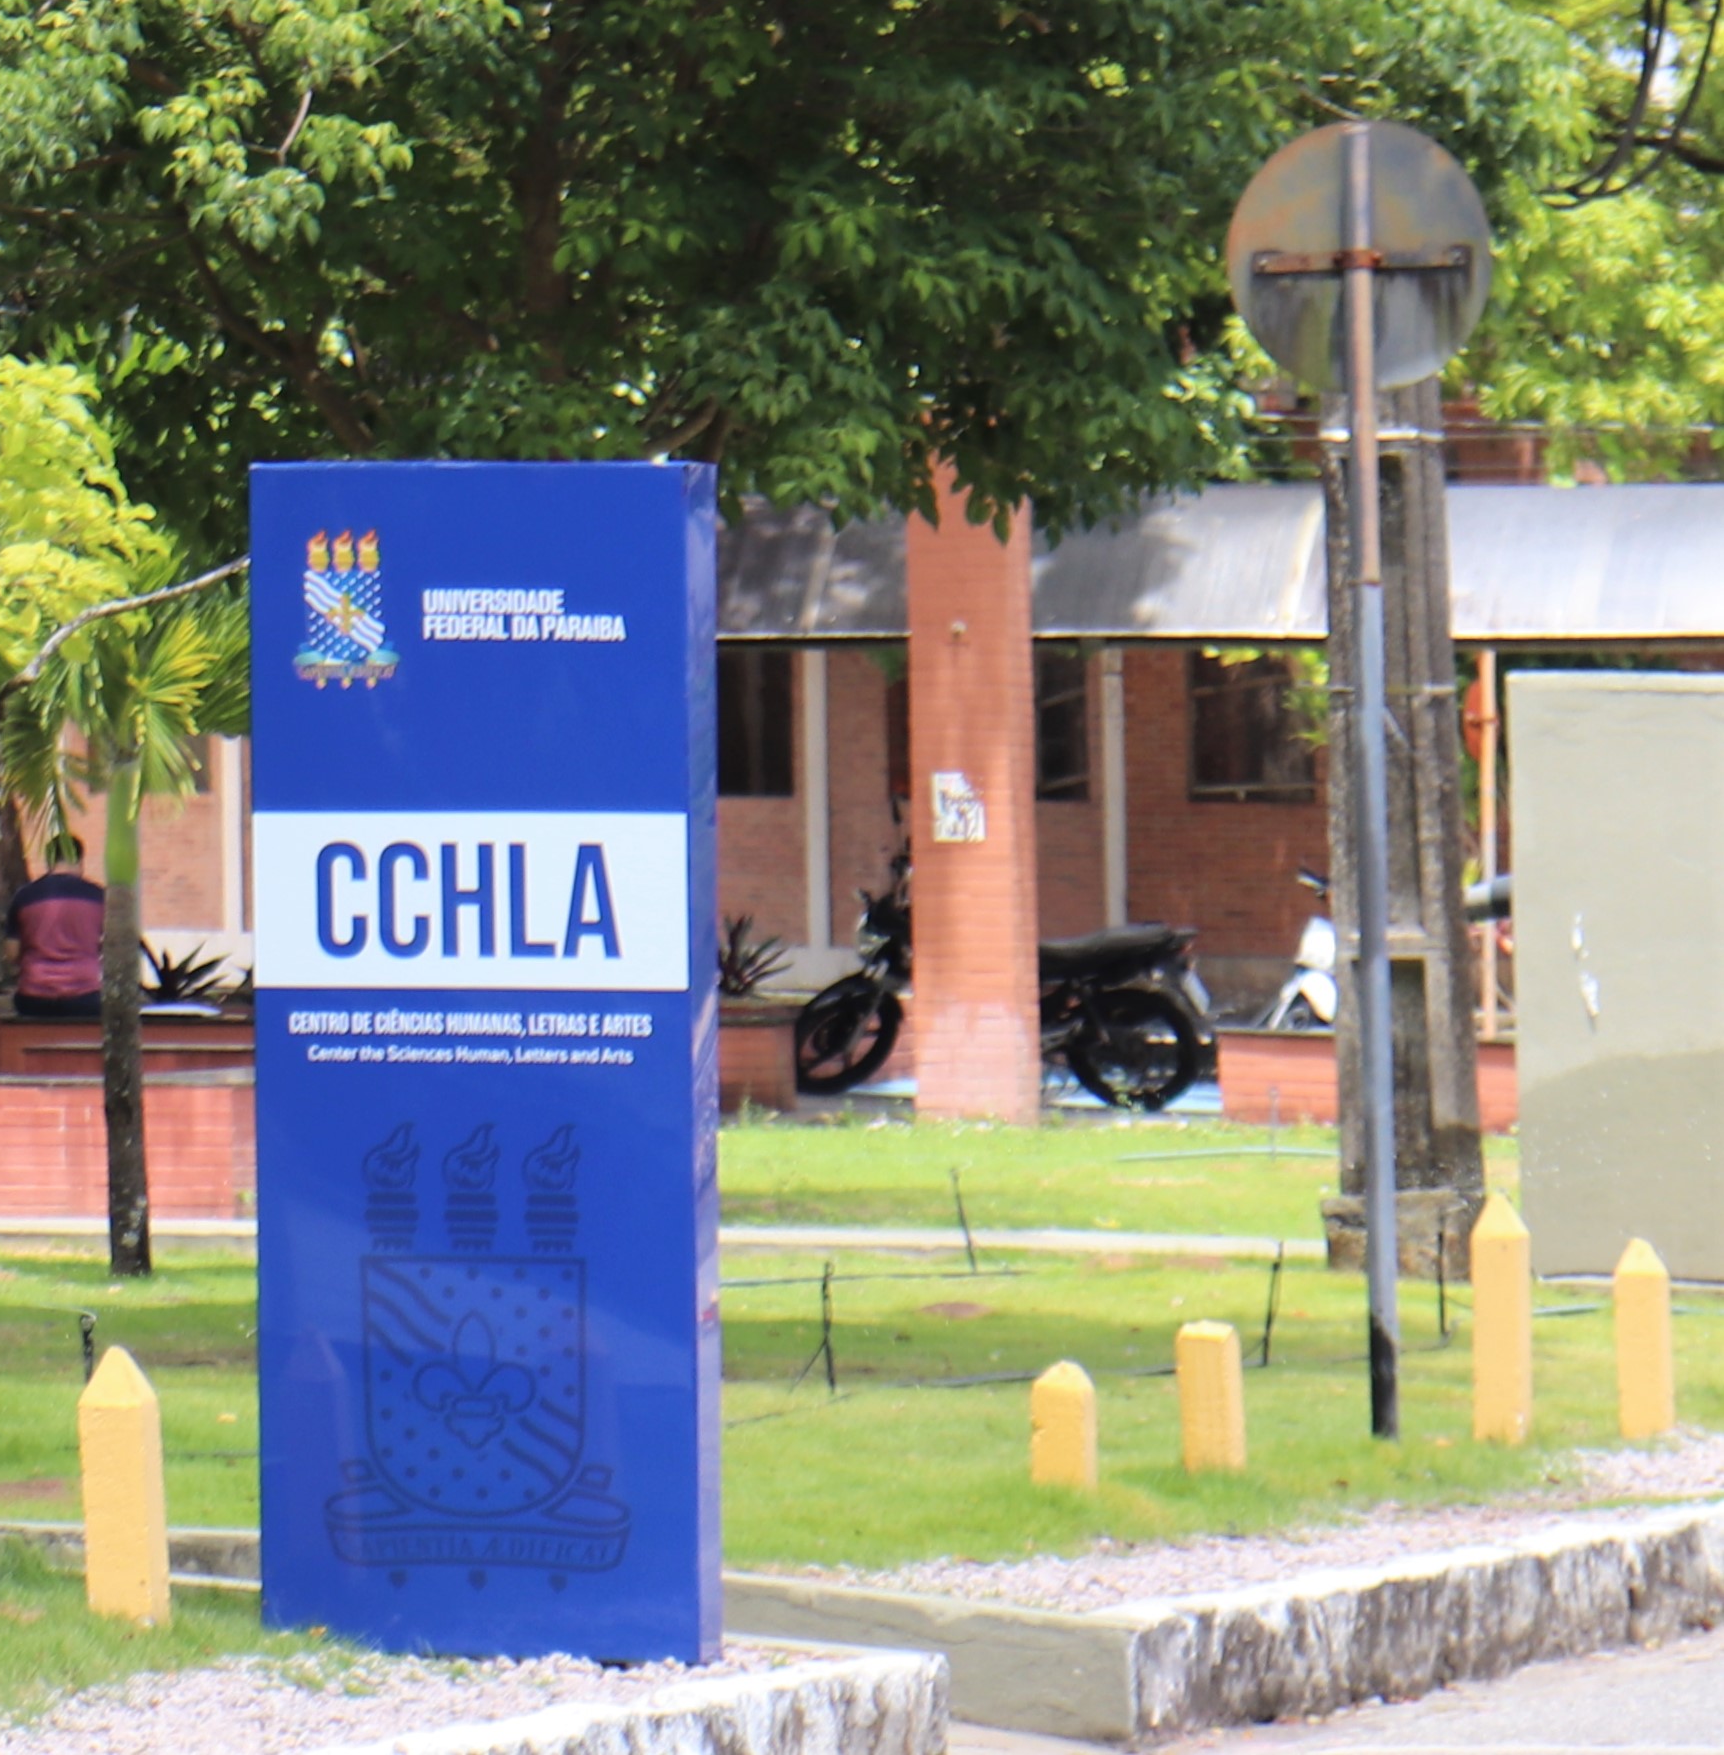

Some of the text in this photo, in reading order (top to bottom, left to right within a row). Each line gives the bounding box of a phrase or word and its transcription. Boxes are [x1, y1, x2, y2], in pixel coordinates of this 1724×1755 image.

[423, 589, 565, 614] UNIVERSIDADE
[423, 615, 509, 640] FEDERAL
[511, 615, 539, 640] DA
[316, 841, 621, 958] CCHLA
[289, 1007, 653, 1039] CENTRO DE CIÊNCIAS HUMANAS, LETRAS E ARTES
[307, 1044, 635, 1065] Center the Sciences Human, Letters and Arts
